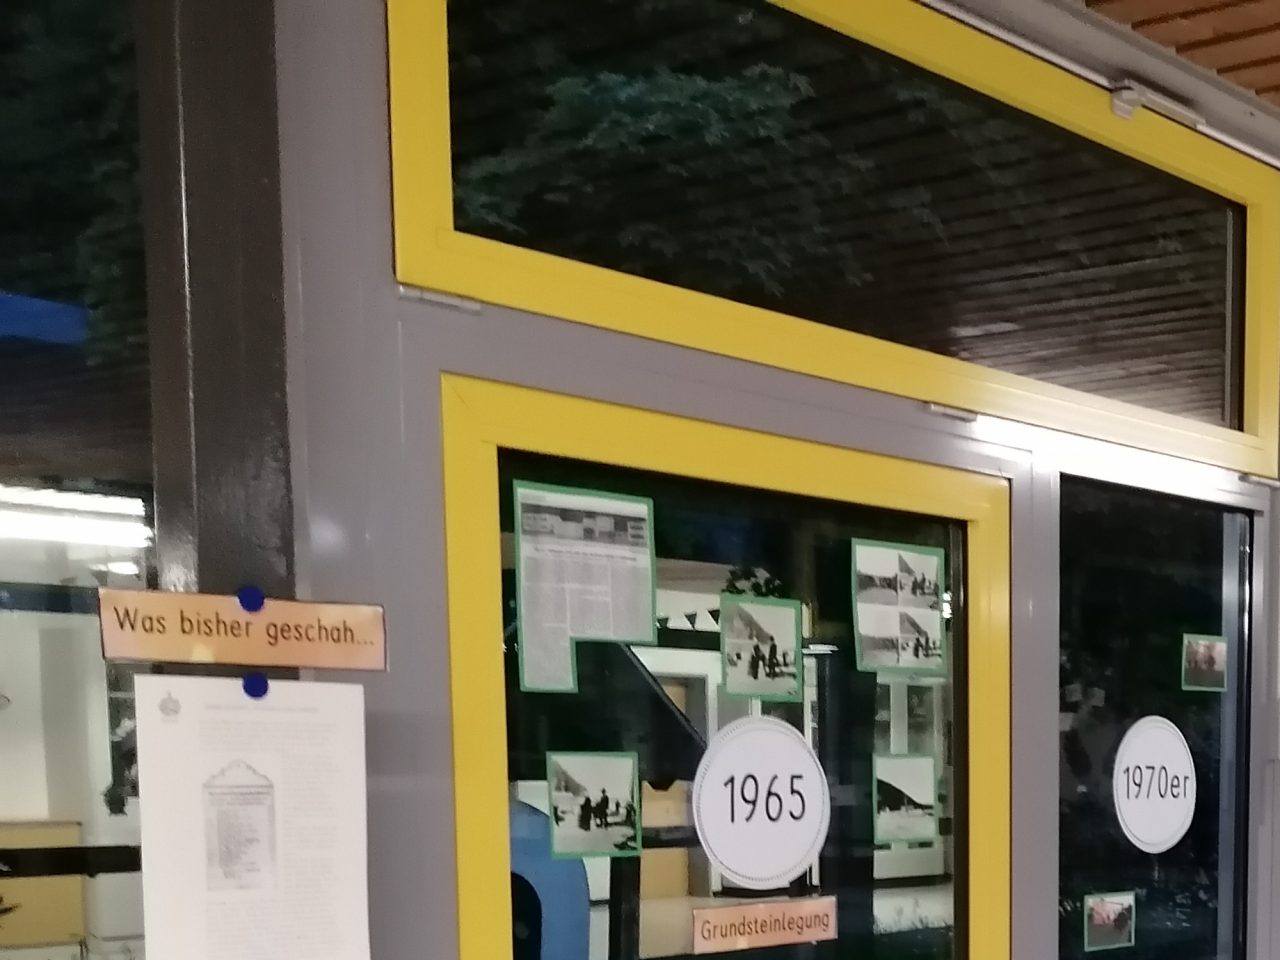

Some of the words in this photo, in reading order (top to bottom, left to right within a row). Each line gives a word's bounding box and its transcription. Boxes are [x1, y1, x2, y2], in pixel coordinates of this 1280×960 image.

[113, 605, 167, 634] Was
[179, 609, 253, 638] bisher
[265, 616, 375, 647] geschah...
[723, 773, 806, 823] 1965
[1122, 764, 1191, 800] 1970er
[700, 911, 831, 941] Grundsteinlegung
